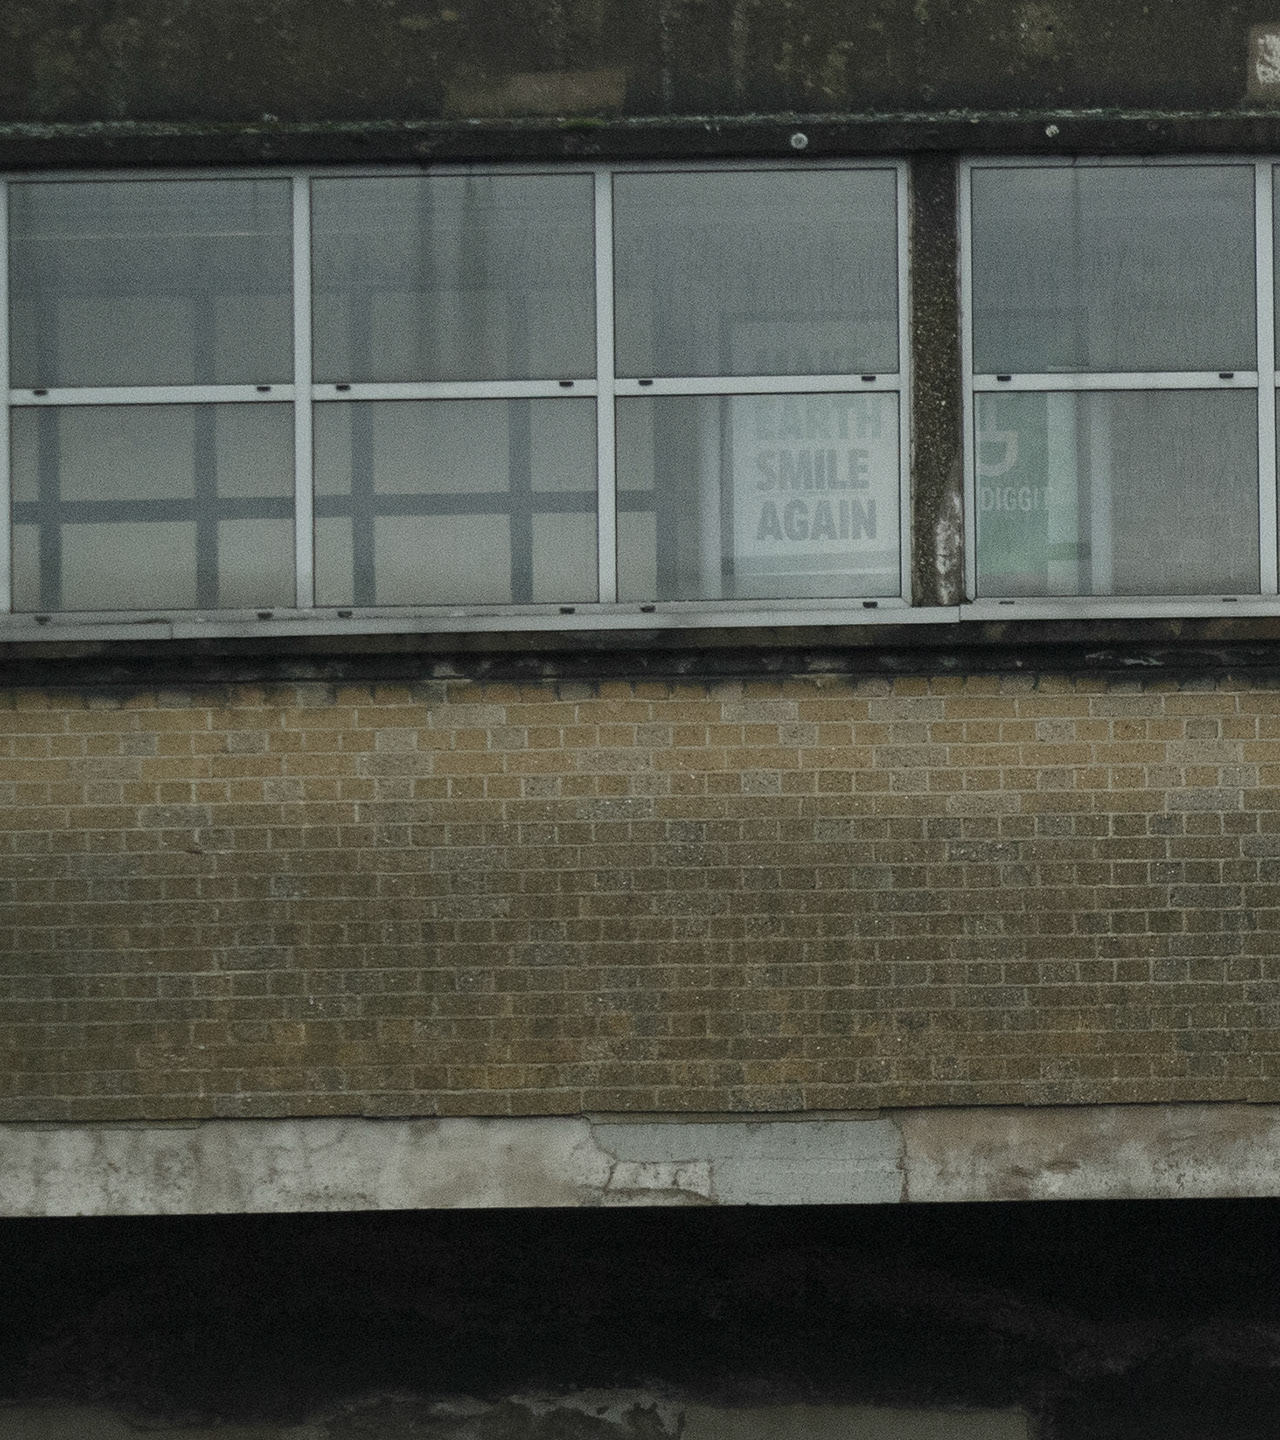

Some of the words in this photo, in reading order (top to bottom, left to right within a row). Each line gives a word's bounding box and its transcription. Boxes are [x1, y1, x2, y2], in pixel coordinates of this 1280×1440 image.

[754, 396, 883, 440] EARTH
[755, 448, 870, 492] SMILE
[755, 498, 878, 541] AGAIN
